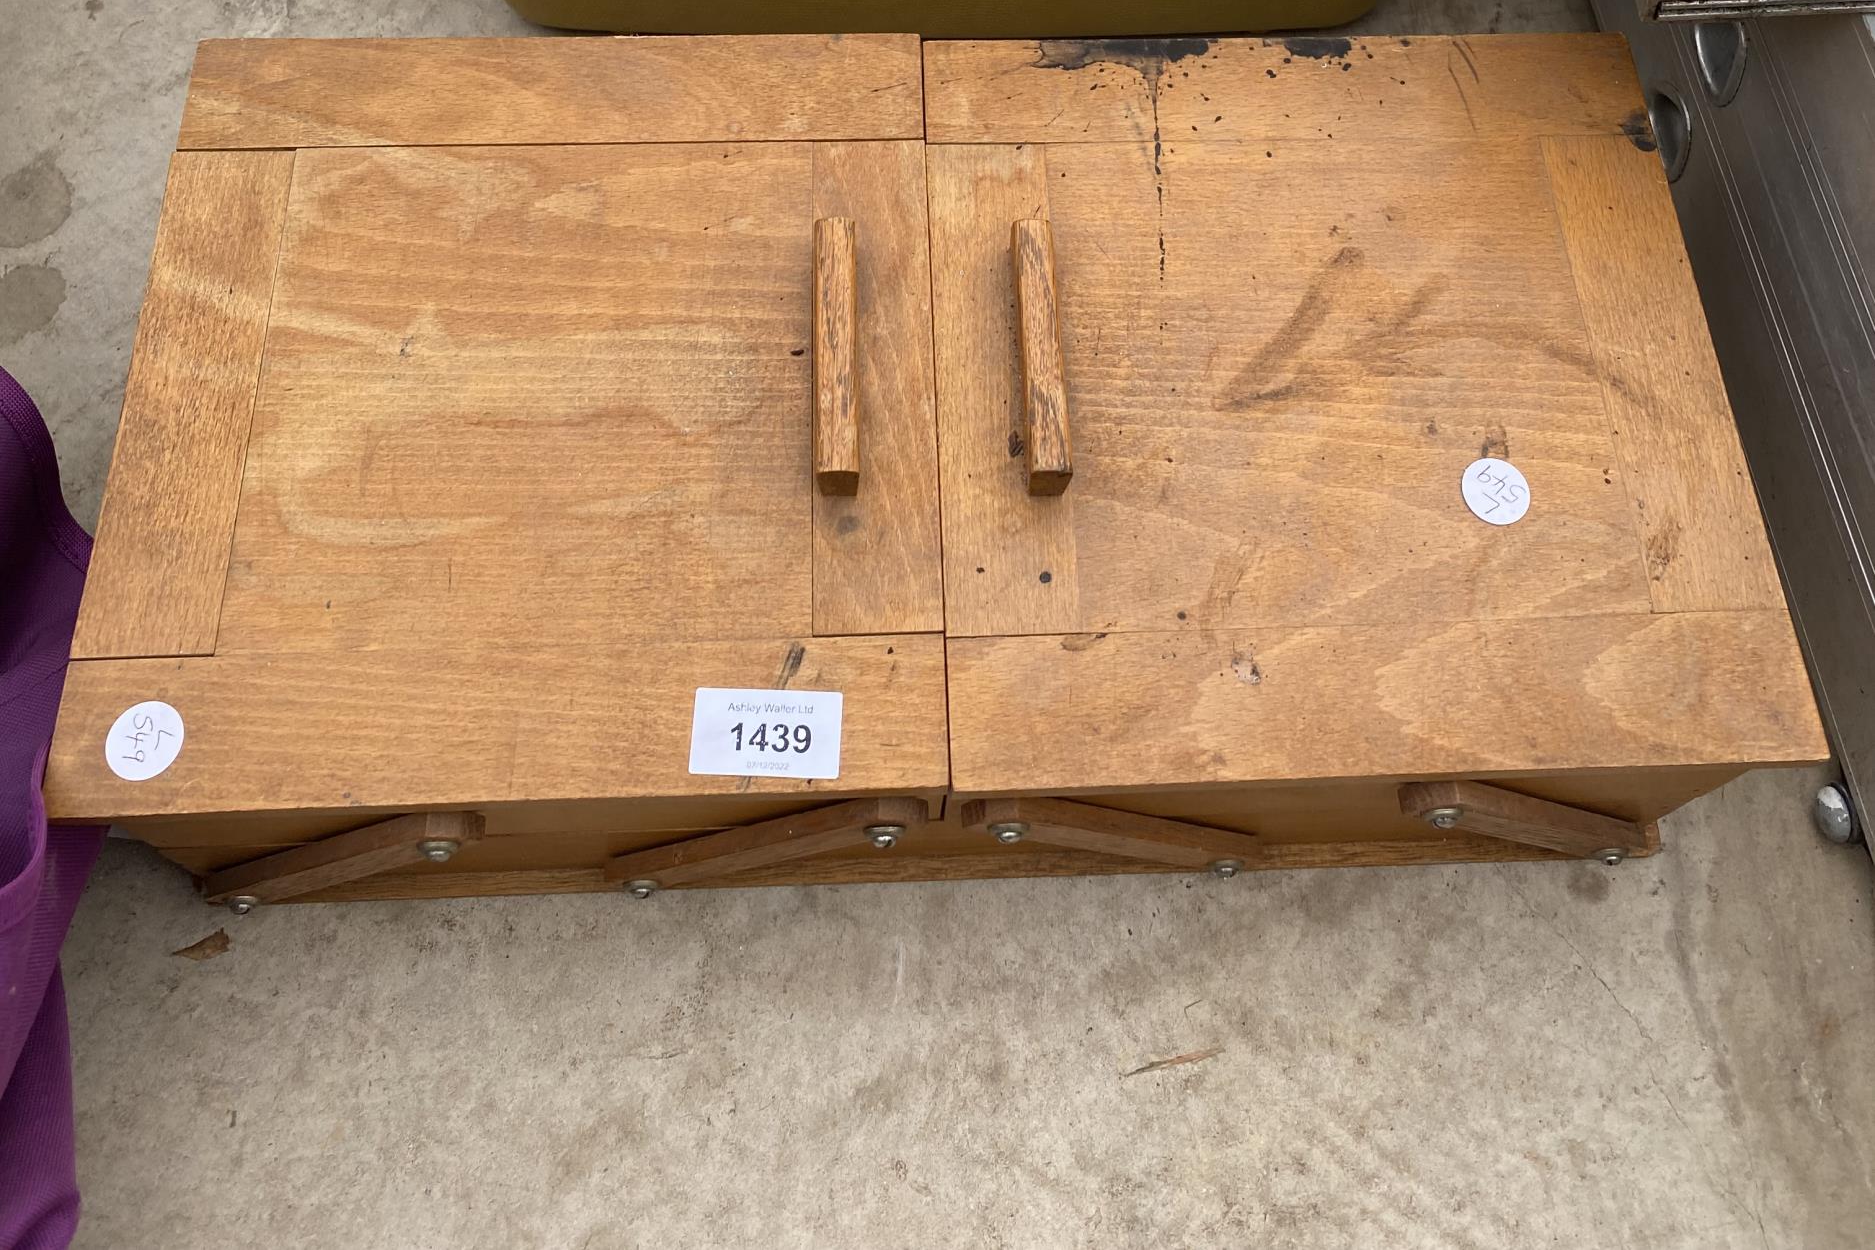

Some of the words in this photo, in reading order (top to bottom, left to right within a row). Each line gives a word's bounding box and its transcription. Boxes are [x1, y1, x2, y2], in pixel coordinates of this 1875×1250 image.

[1476, 464, 1527, 504] 549
[728, 702, 761, 715] Ashley
[764, 703, 796, 714] Waller
[798, 704, 814, 715] Ltd
[121, 712, 154, 763] 549
[730, 722, 813, 754] 1439
